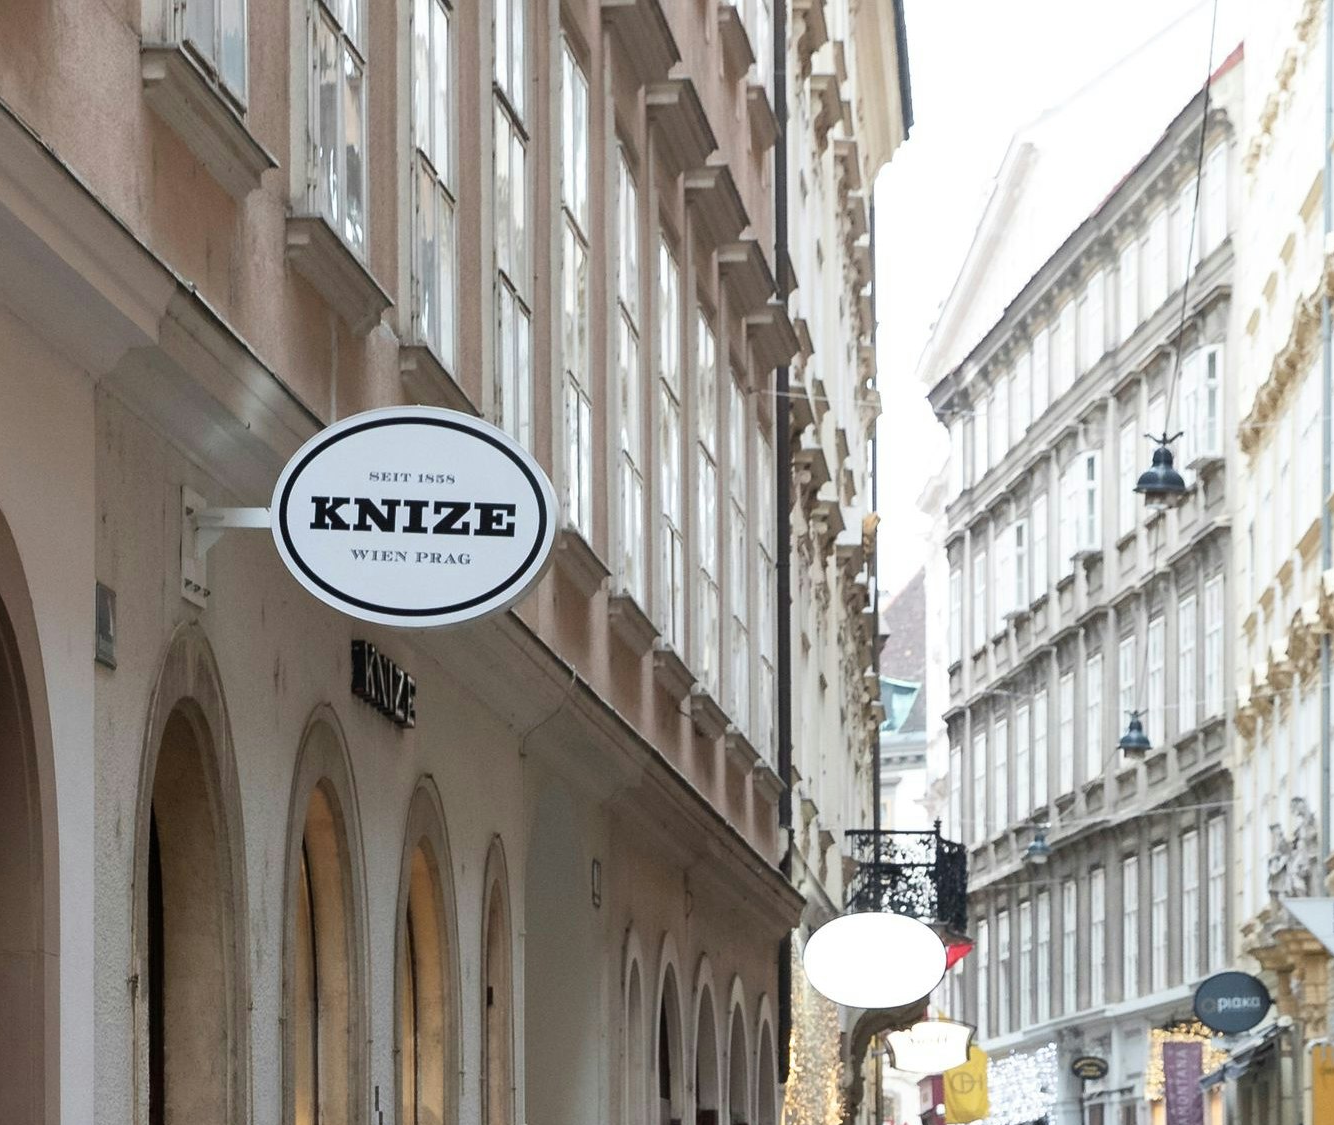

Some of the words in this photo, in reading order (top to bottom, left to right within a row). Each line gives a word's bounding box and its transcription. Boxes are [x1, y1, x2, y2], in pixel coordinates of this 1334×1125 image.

[369, 471, 411, 482] SEIT
[310, 496, 516, 537] KNIZE
[351, 549, 407, 562] WIEN
[415, 551, 471, 565] PRAG
[349, 639, 415, 728] KNIZE
